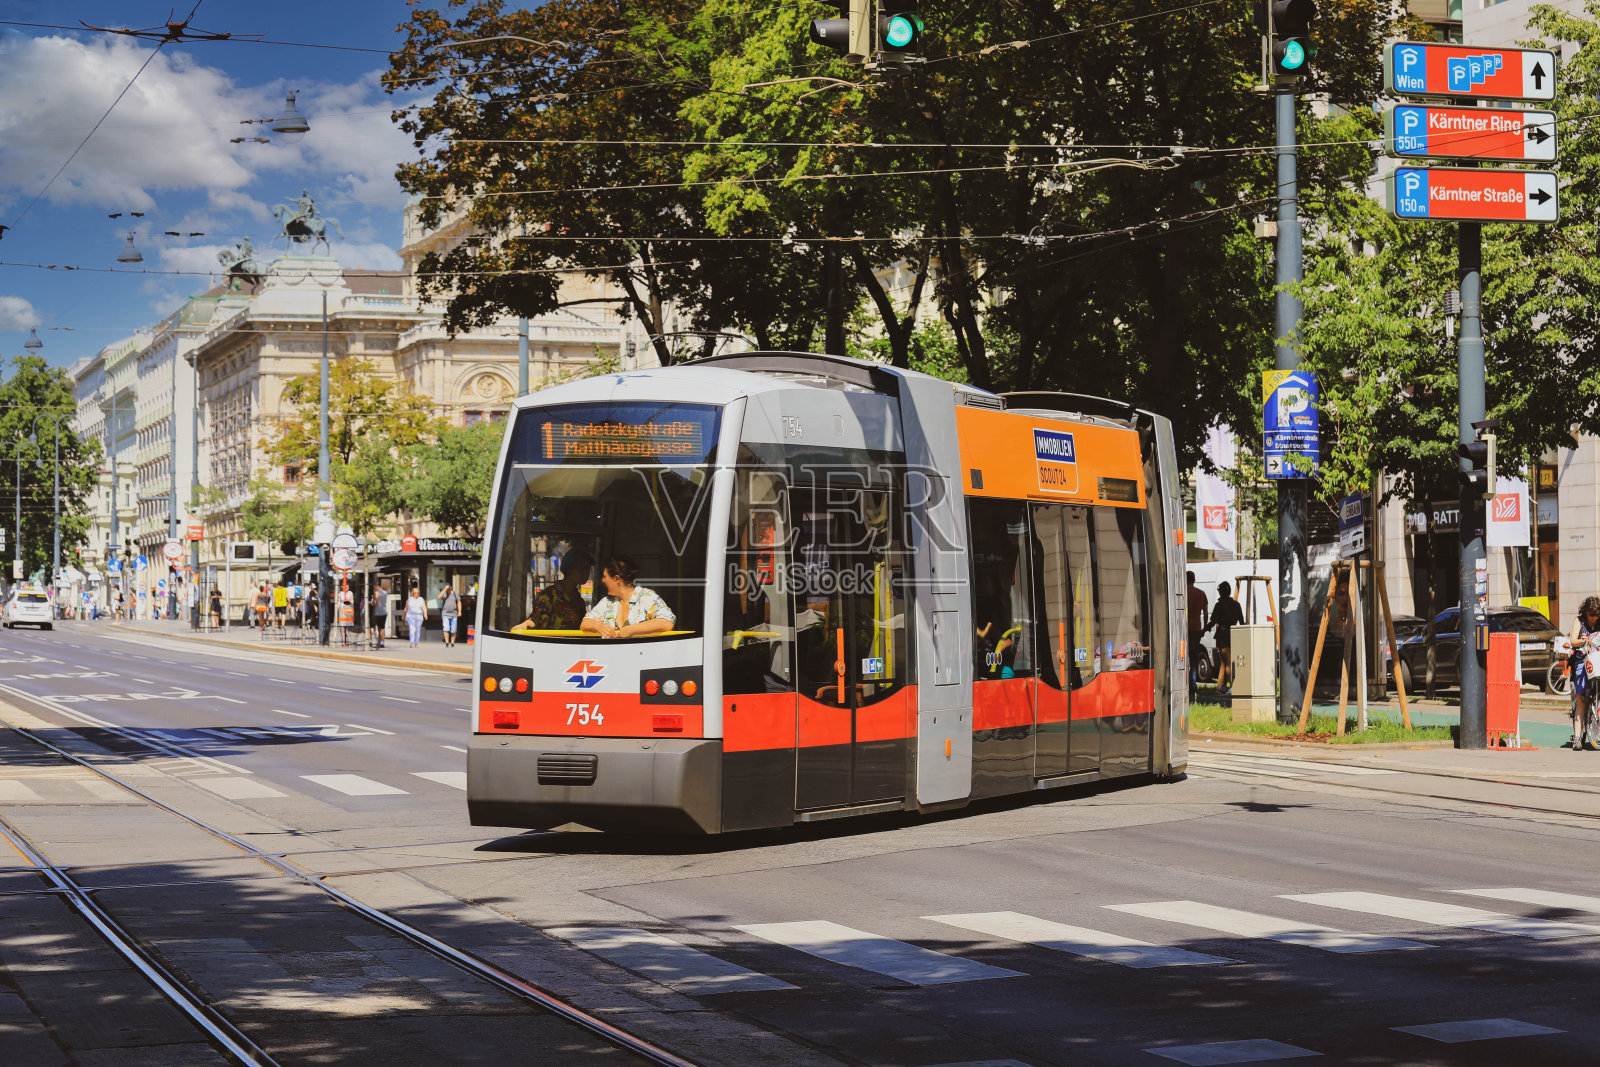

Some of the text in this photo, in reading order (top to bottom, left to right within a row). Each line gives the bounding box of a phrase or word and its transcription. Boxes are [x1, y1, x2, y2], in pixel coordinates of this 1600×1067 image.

[1397, 75, 1424, 89] Wien
[1429, 112, 1521, 135] Kärntner Ring
[1398, 136, 1424, 150] 550 m
[1430, 186, 1523, 203] Kärntner Straße
[1400, 199, 1426, 213] 150 m
[782, 415, 803, 438] 754
[541, 421, 694, 459] 1 Radetzkystraße
[565, 440, 693, 457] Matthäusgasse
[1036, 436, 1073, 457] IMMOBILIEN
[566, 703, 604, 726] 754
